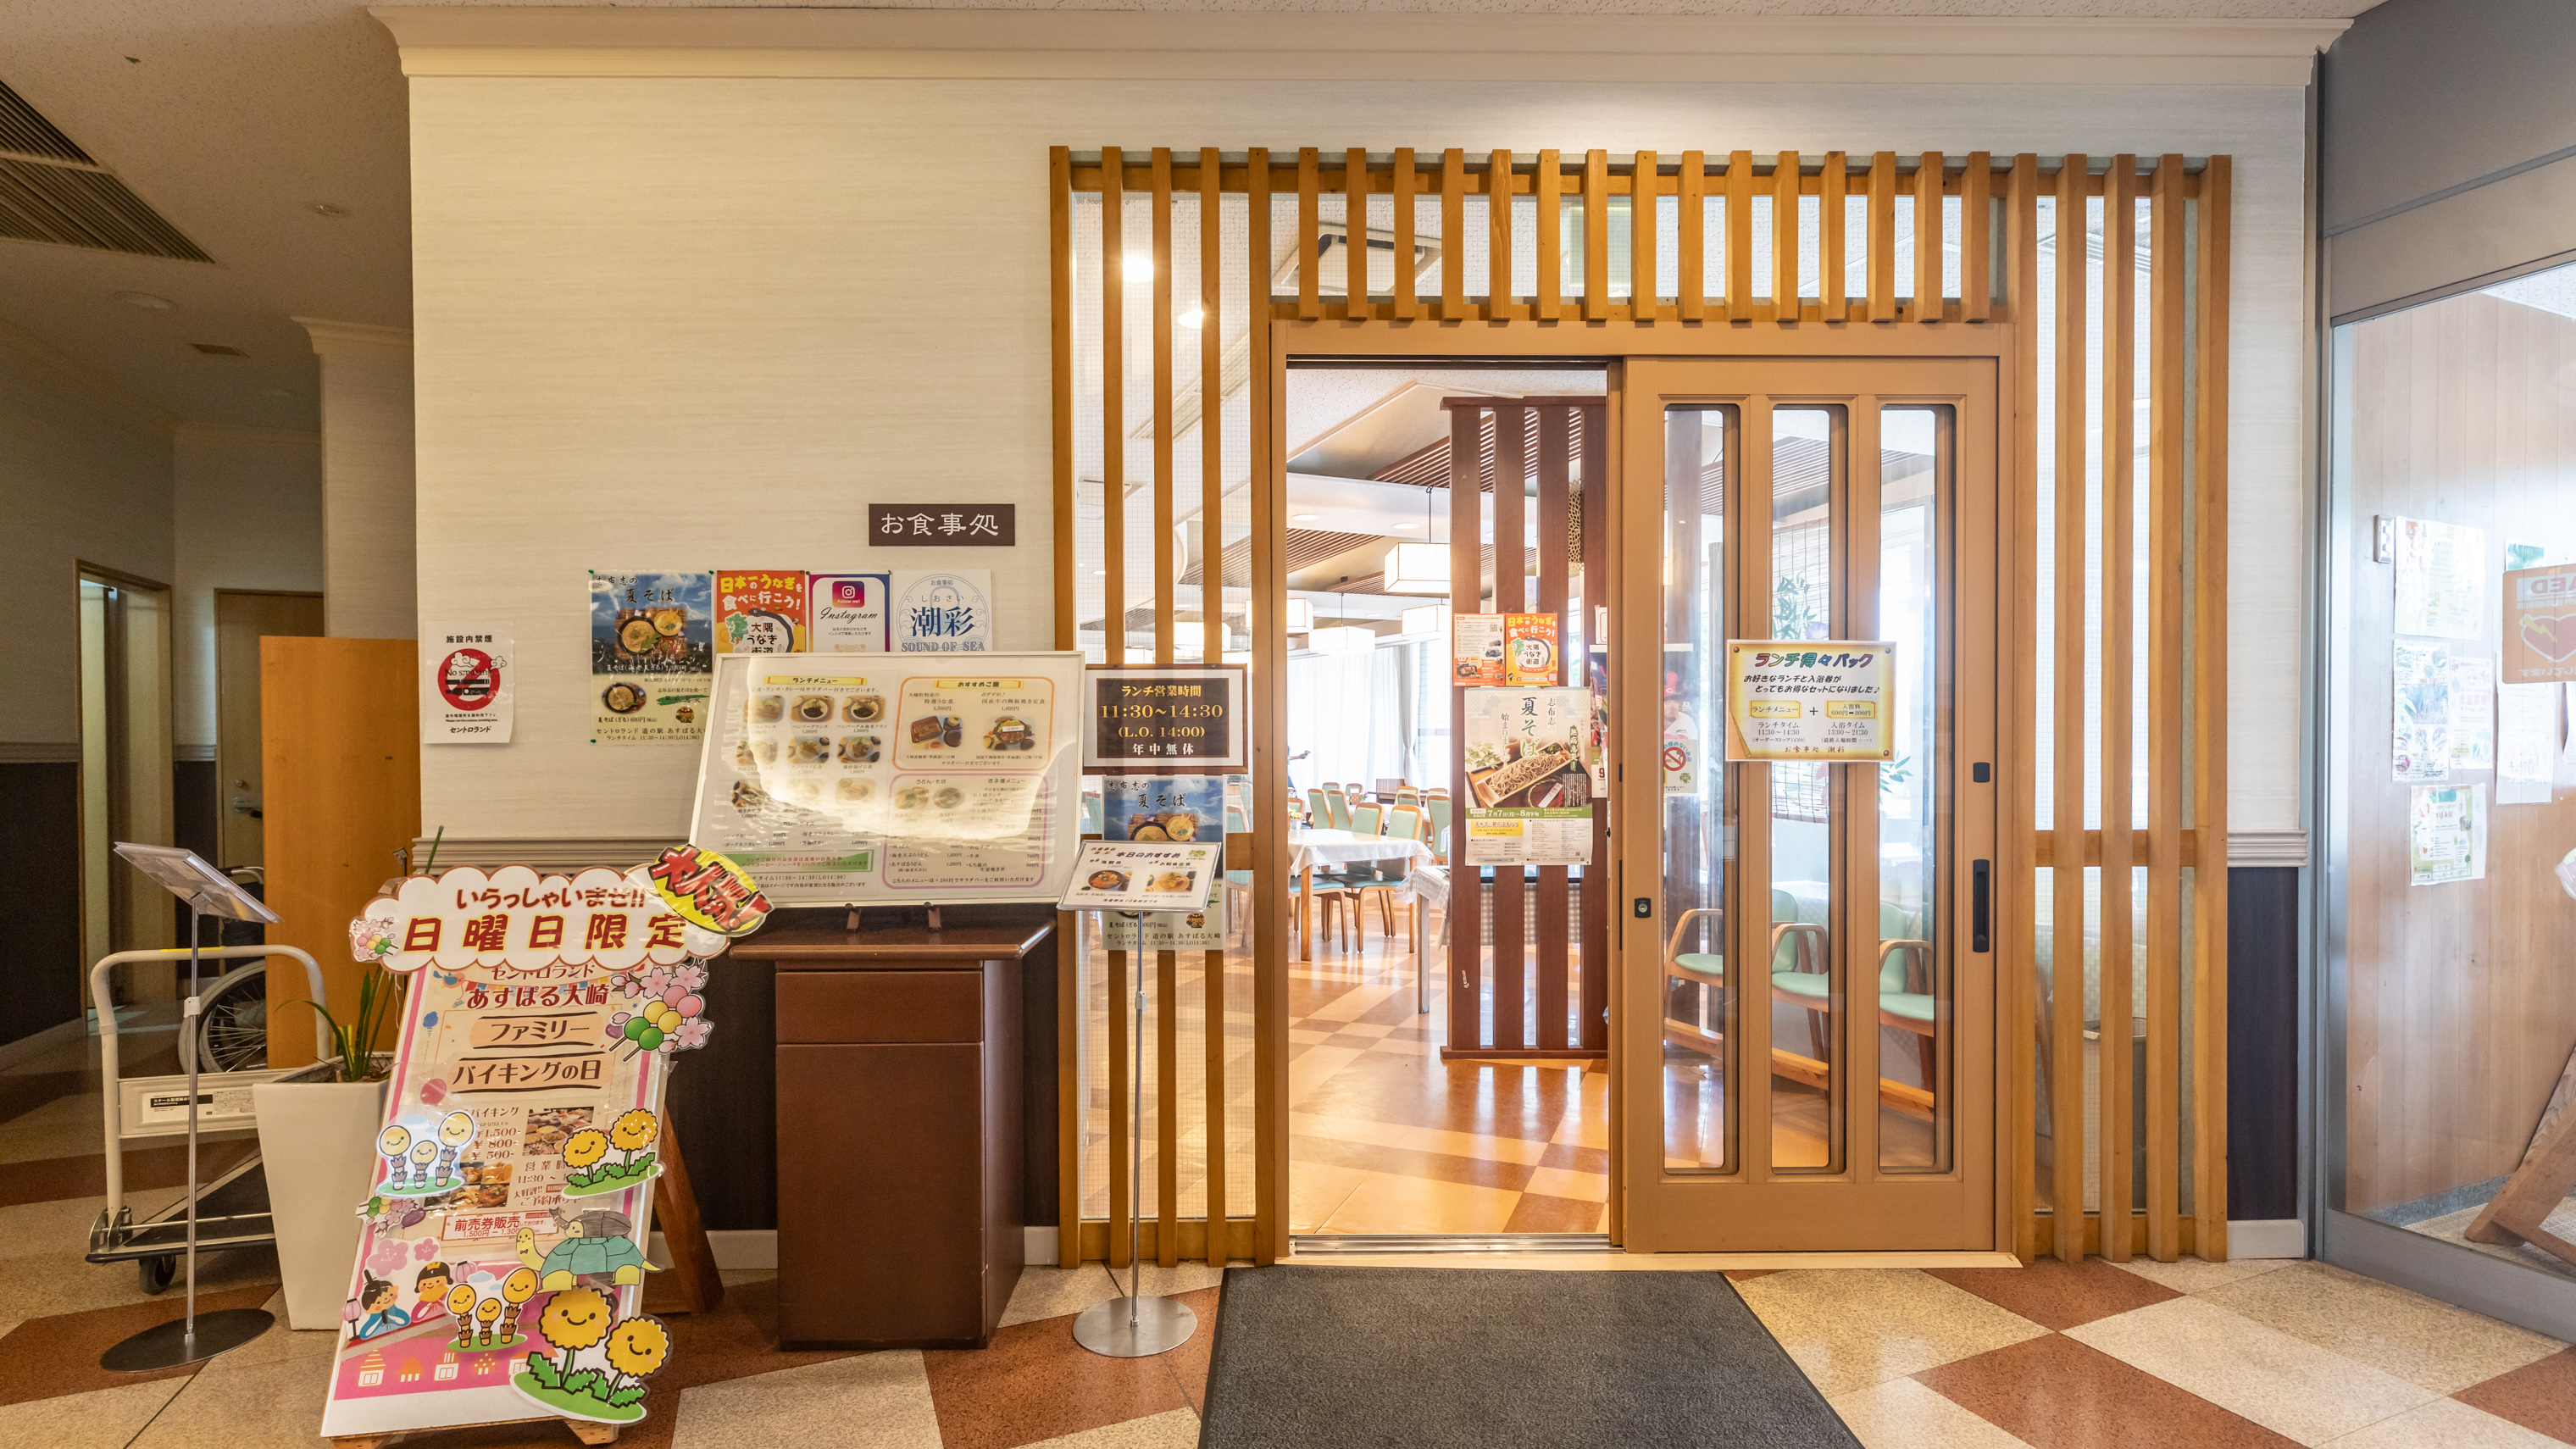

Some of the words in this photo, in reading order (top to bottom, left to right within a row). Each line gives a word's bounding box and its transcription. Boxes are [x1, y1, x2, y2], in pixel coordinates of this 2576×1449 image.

[881, 513, 998, 536] お食事処
[720, 574, 802, 593] 日本一のうなぎを
[626, 588, 675, 603] 夏そば
[722, 591, 801, 611] 食べに行こう!
[820, 607, 878, 624] Instagram
[910, 606, 975, 637] 潮彩
[751, 623, 773, 632] 大隅
[1509, 625, 1555, 637] 食べに行こう!
[446, 635, 492, 643] 施設内禁煙
[747, 634, 778, 645] うなぎ
[901, 641, 939, 652] SOUND
[941, 641, 957, 652] OF
[963, 641, 985, 652] SEA
[1755, 652, 1874, 668] ランチ得々パック
[1121, 685, 1202, 697] ランチ営業時間
[1101, 704, 1223, 719] 11:30～14:30
[1118, 726, 1153, 738] (L.O.
[1160, 726, 1205, 738] 14:00)
[1520, 697, 1540, 757] 夏そば
[1132, 743, 1194, 755] 年中無休
[1107, 780, 1150, 791] 志布志の
[1138, 793, 1186, 808] 夏そば
[456, 886, 646, 909] いらっしゃいませ!!
[402, 913, 687, 952] 日曜日限定
[491, 964, 595, 980] セントロランド
[466, 983, 609, 1009] あすぱる大崎
[490, 1020, 591, 1042] ファミリー
[452, 1059, 602, 1085] バイキングの日
[518, 1174, 544, 1184] 11:30
[454, 1216, 520, 1231] 前売券販売
